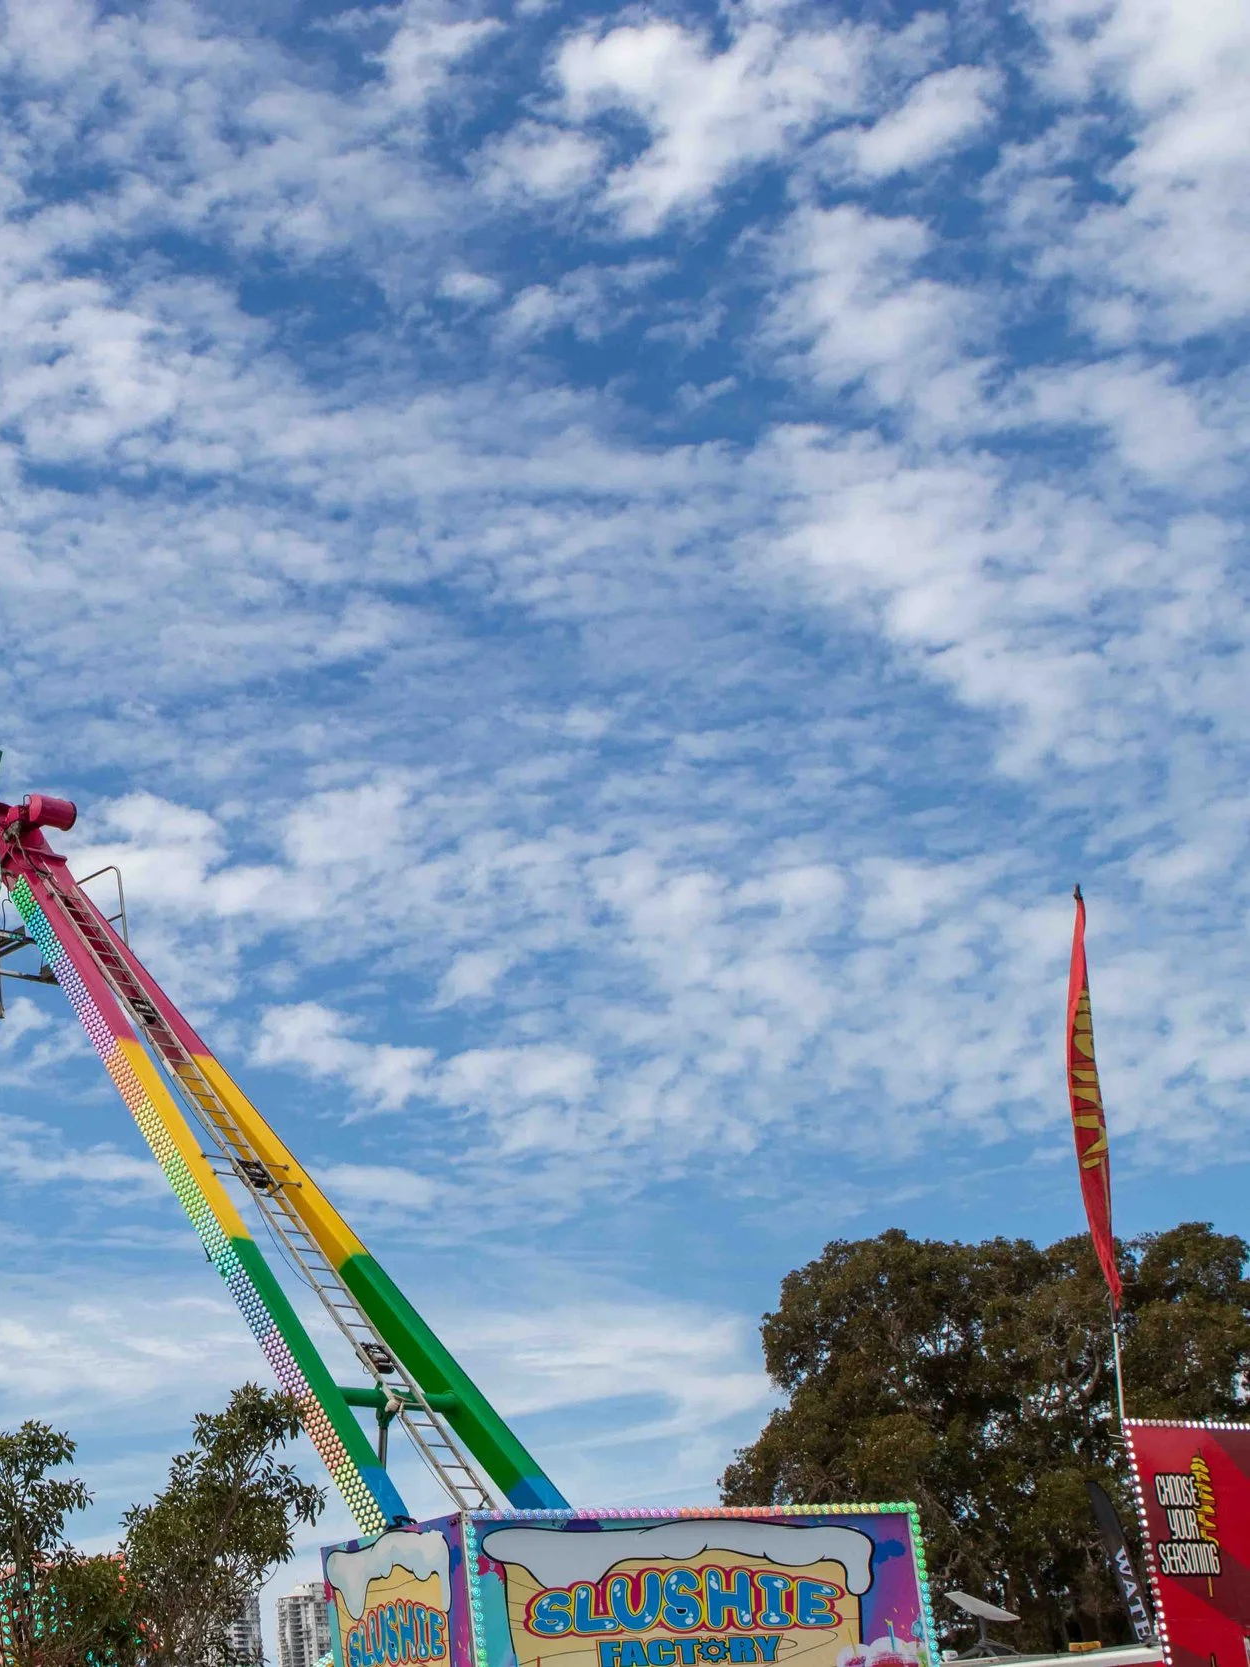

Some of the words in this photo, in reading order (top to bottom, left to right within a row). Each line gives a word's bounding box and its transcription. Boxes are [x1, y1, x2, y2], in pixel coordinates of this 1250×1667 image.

[1155, 1473, 1200, 1506] CHOOSE
[1166, 1508, 1200, 1540] YOUR
[1158, 1542, 1221, 1574] SEASONING
[529, 1566, 841, 1637] SLUSHIE
[349, 1600, 446, 1667] SLUSHIE
[599, 1634, 781, 1667] FACTORY
